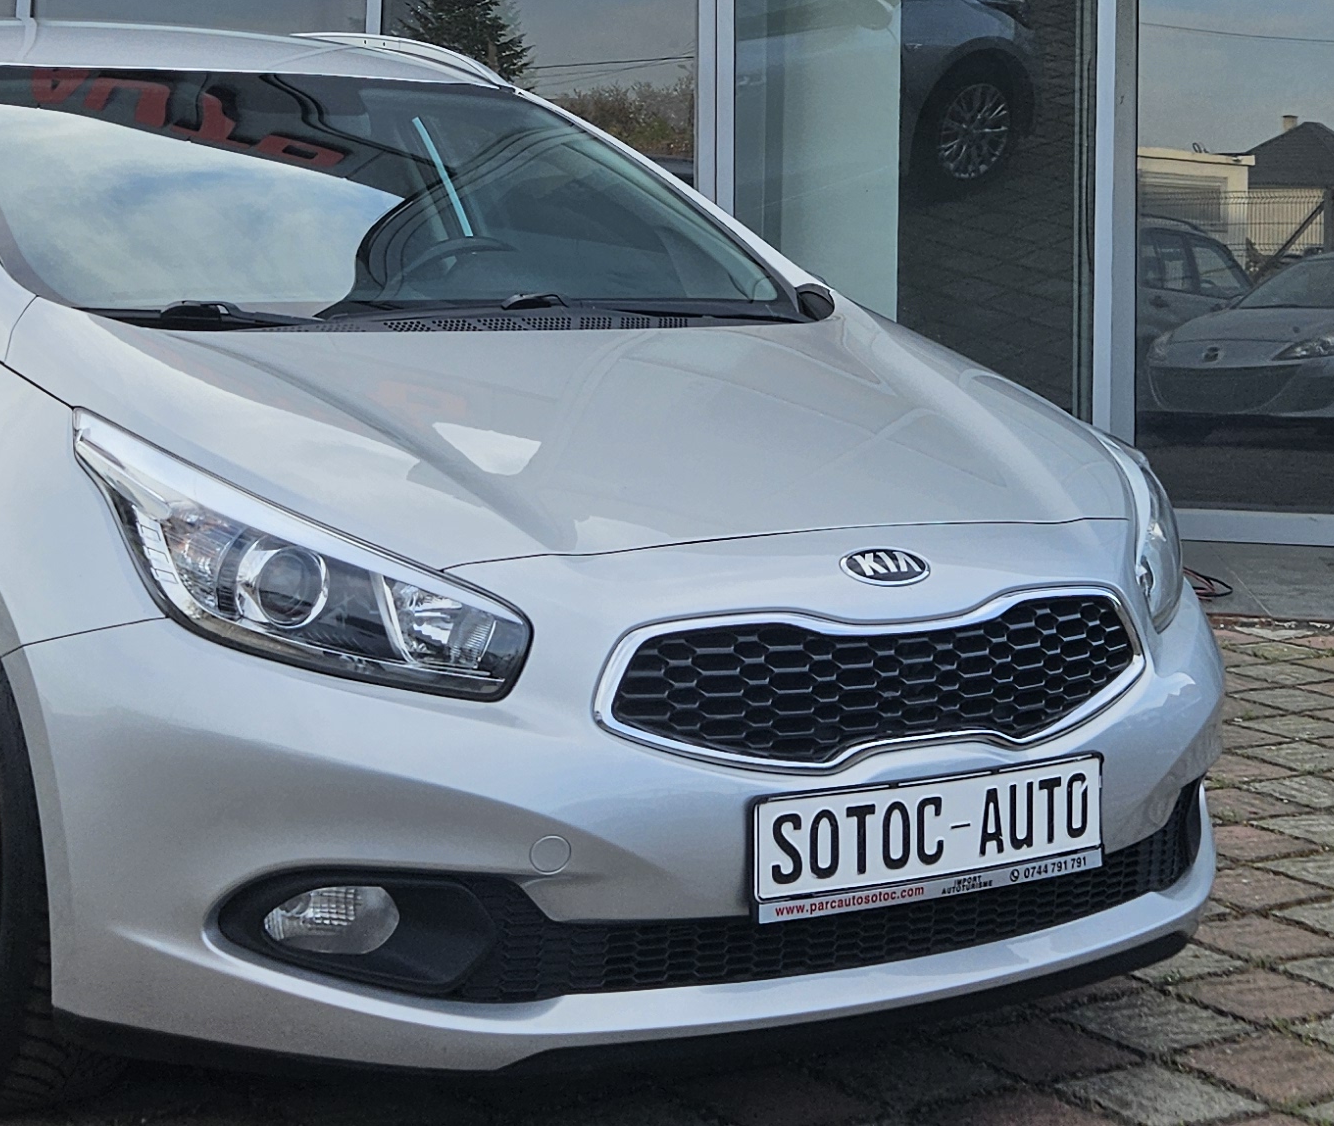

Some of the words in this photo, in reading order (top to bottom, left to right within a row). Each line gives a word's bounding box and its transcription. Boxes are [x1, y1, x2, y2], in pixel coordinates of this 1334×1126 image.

[852, 551, 923, 576] KIA
[1023, 867, 1049, 879] 0744
[1051, 861, 1068, 873] 791
[1070, 856, 1087, 869] 791
[953, 875, 982, 887] IMPORT
[774, 885, 925, 917] www.parcautosotoc.com
